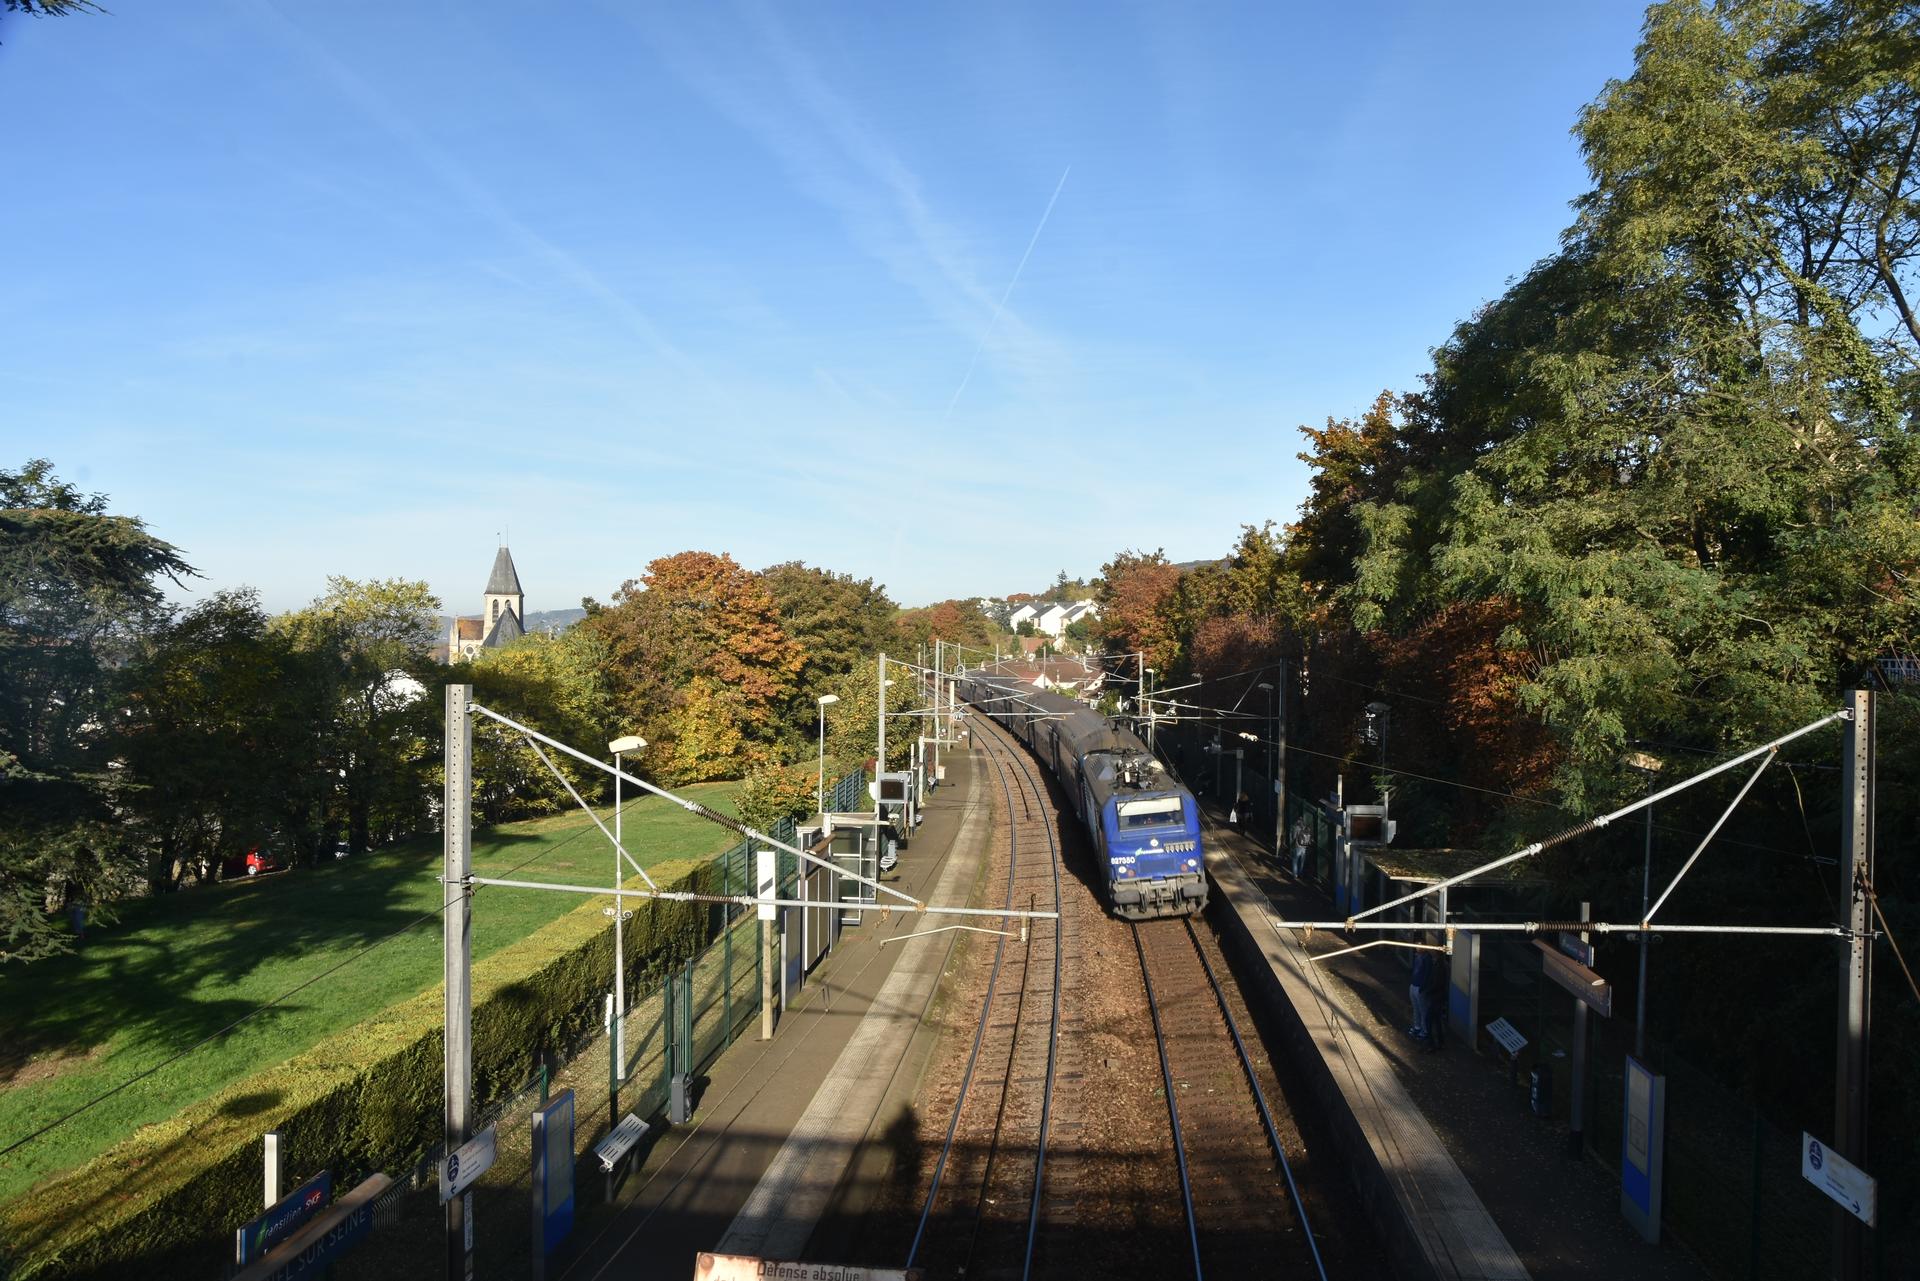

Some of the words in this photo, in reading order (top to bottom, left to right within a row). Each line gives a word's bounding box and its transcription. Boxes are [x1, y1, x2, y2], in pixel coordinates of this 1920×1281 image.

[304, 1191, 321, 1210] SNCF
[298, 1240, 325, 1272] SUR
[330, 1207, 365, 1246] SEINE
[757, 1261, 807, 1279] Défense
[812, 1266, 860, 1281] absolue
